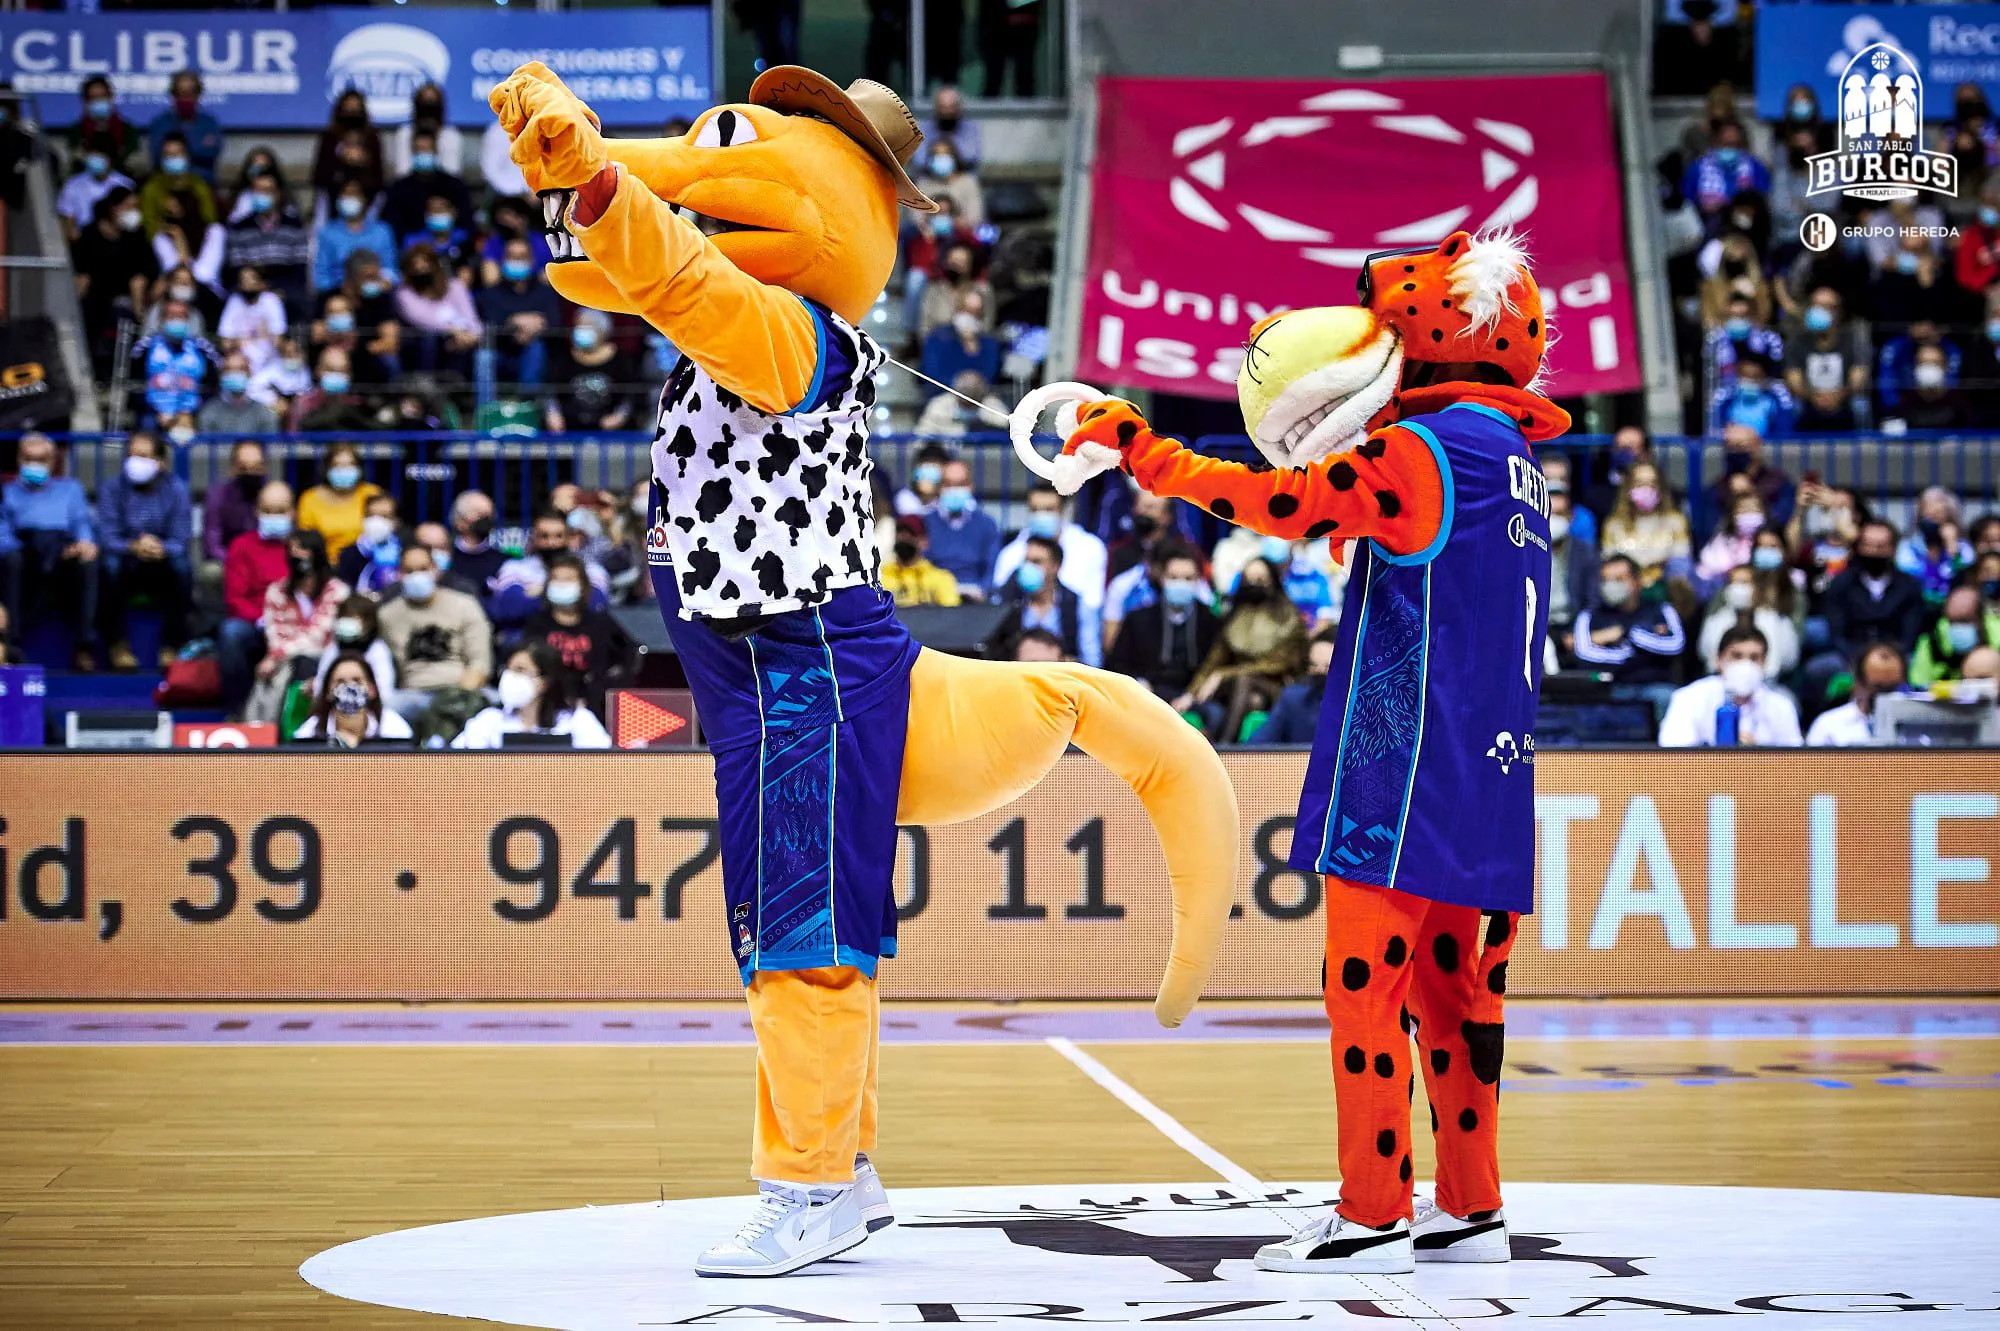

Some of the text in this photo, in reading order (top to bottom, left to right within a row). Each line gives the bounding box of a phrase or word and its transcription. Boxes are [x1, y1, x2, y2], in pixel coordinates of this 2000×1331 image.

[0, 29, 298, 73] CLIBUR
[661, 47, 685, 72] Y
[170, 816, 321, 921] 39
[489, 816, 721, 921] 947
[986, 816, 1125, 920] 11
[1228, 815, 1321, 920] 8
[1534, 792, 2000, 951] TALLE
[637, 1292, 2000, 1326] ARZUAG
